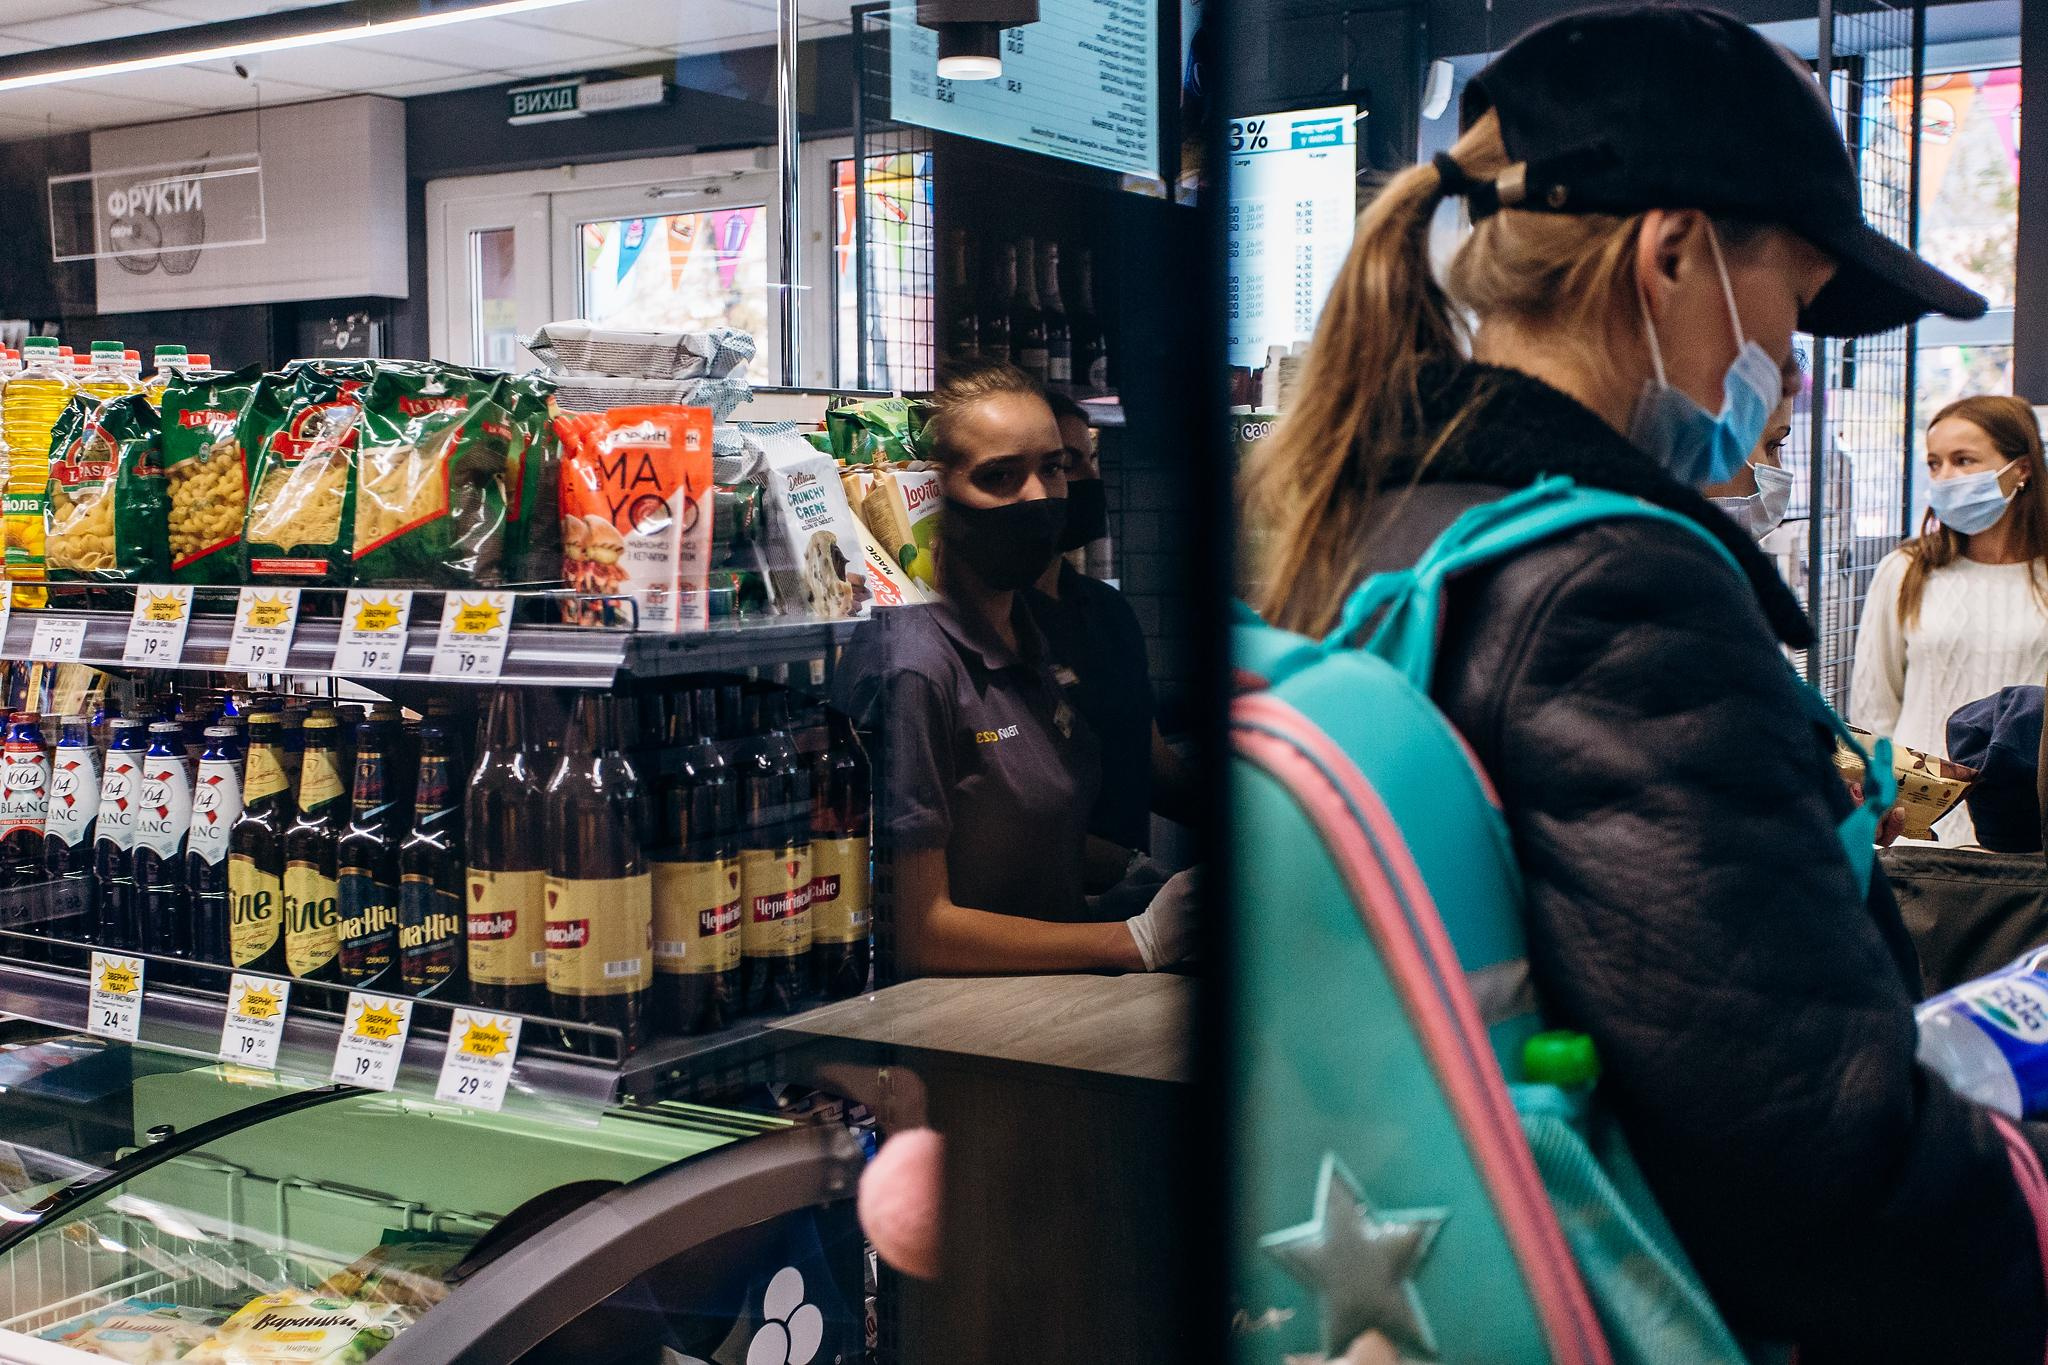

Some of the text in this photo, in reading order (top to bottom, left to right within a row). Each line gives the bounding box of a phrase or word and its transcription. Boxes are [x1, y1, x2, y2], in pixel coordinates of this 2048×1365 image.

[513, 88, 574, 115] ВИХІД
[107, 180, 203, 218] ФРУКТИ
[787, 485, 826, 507] CRUNCHY
[865, 545, 894, 576] MAGIC
[50, 637, 62, 652] 19
[144, 638, 157, 655] 19
[250, 645, 265, 662] 19
[361, 651, 377, 668] 19
[459, 654, 476, 672] 19
[7, 769, 41, 786] 1664
[1, 801, 49, 814] BLANC
[229, 888, 272, 925] іле
[103, 1010, 119, 1028] 24
[241, 1036, 254, 1054] 19
[355, 1056, 370, 1075] 19
[458, 1076, 480, 1096] 29
